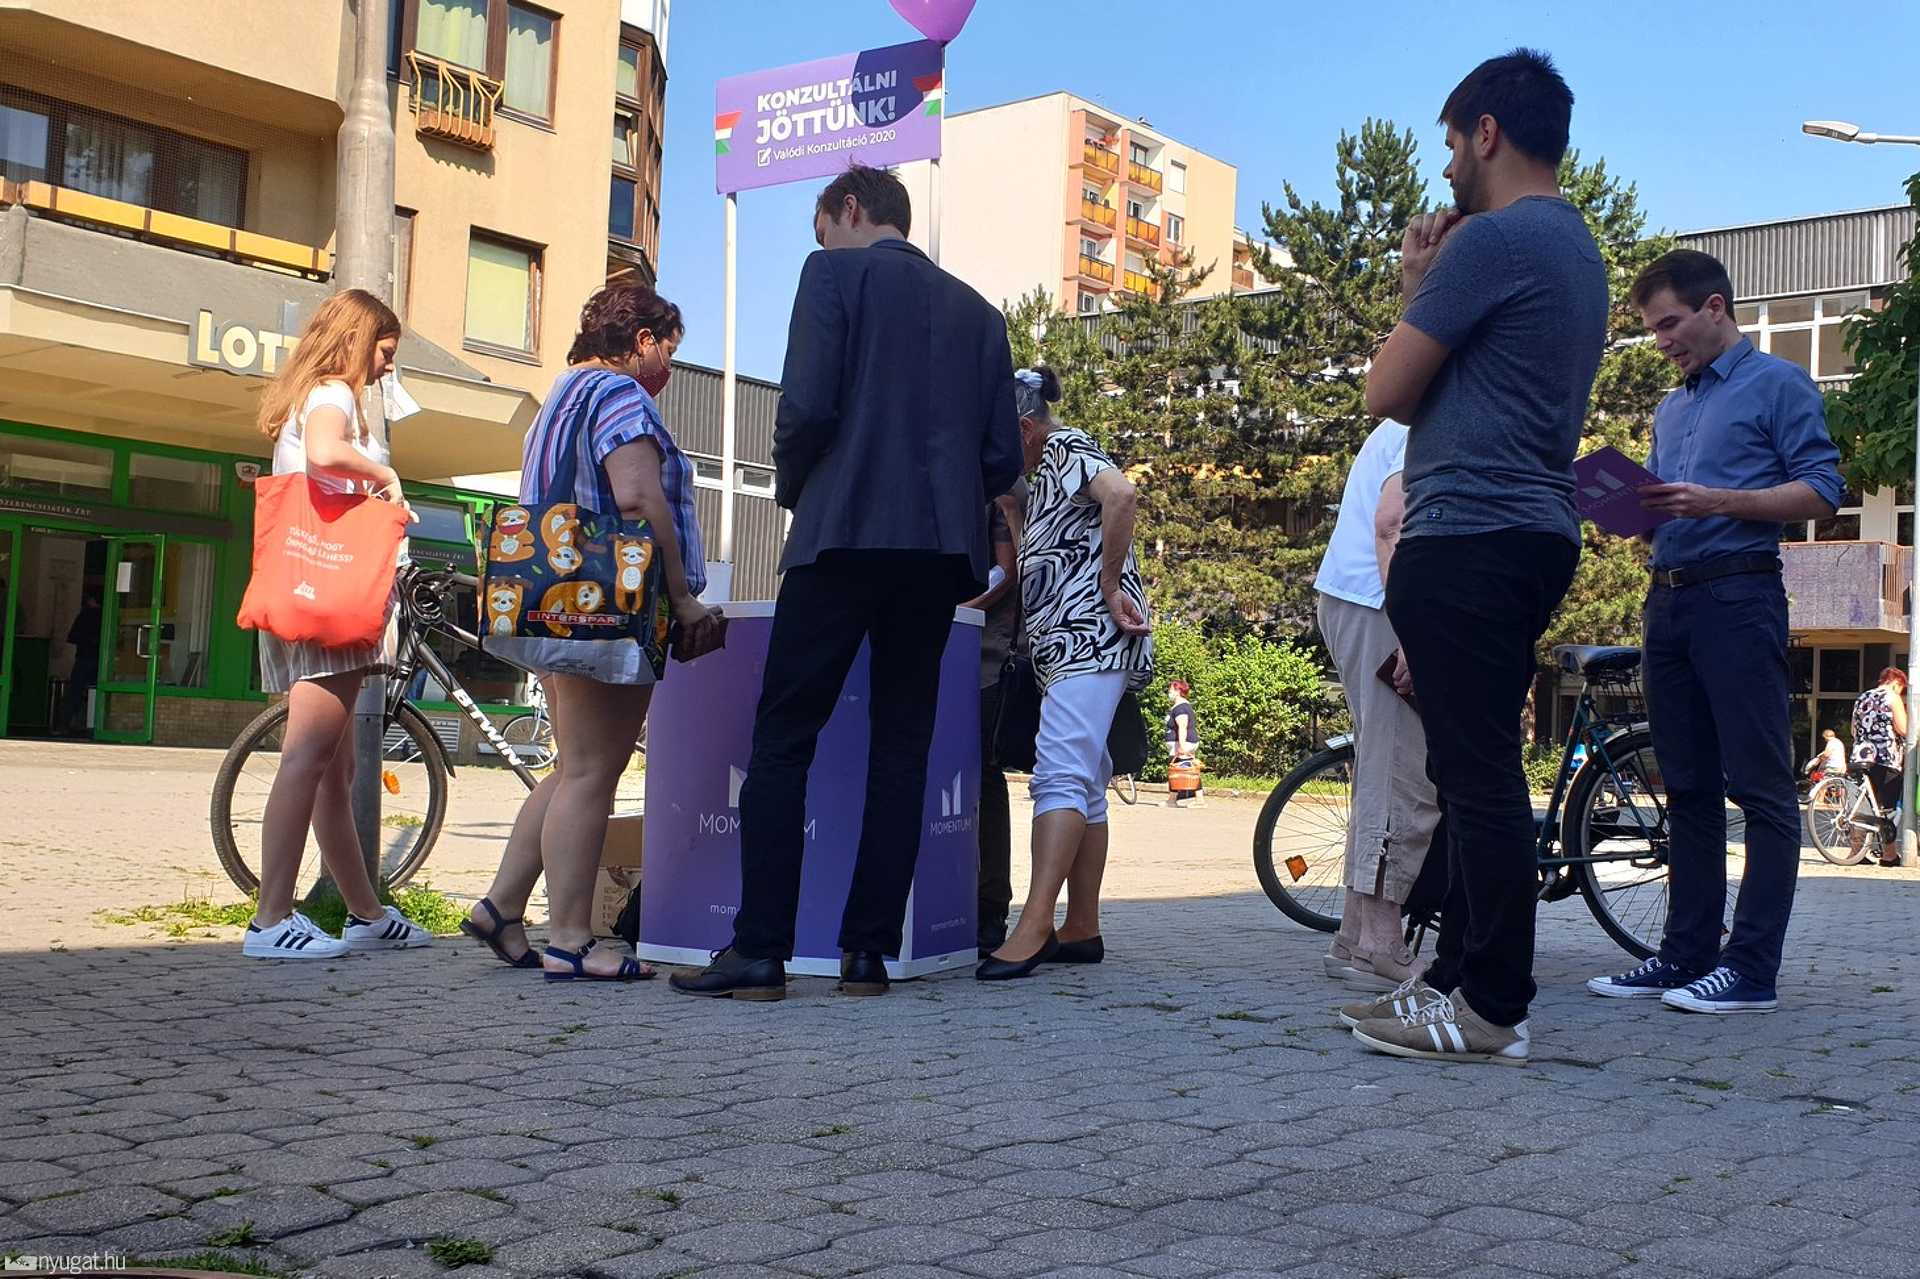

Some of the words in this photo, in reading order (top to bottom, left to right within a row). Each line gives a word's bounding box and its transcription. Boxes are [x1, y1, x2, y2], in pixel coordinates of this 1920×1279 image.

[757, 70, 897, 113] KONZULTÁLNI
[755, 95, 896, 145] JÖTTÜNK!
[774, 143, 806, 161] Valódi
[807, 133, 868, 155] Konzultáció
[869, 129, 896, 146] 2020
[197, 310, 302, 374] LOTT
[536, 610, 617, 625] INTERSPAR
[929, 820, 973, 837] MOMENTUM
